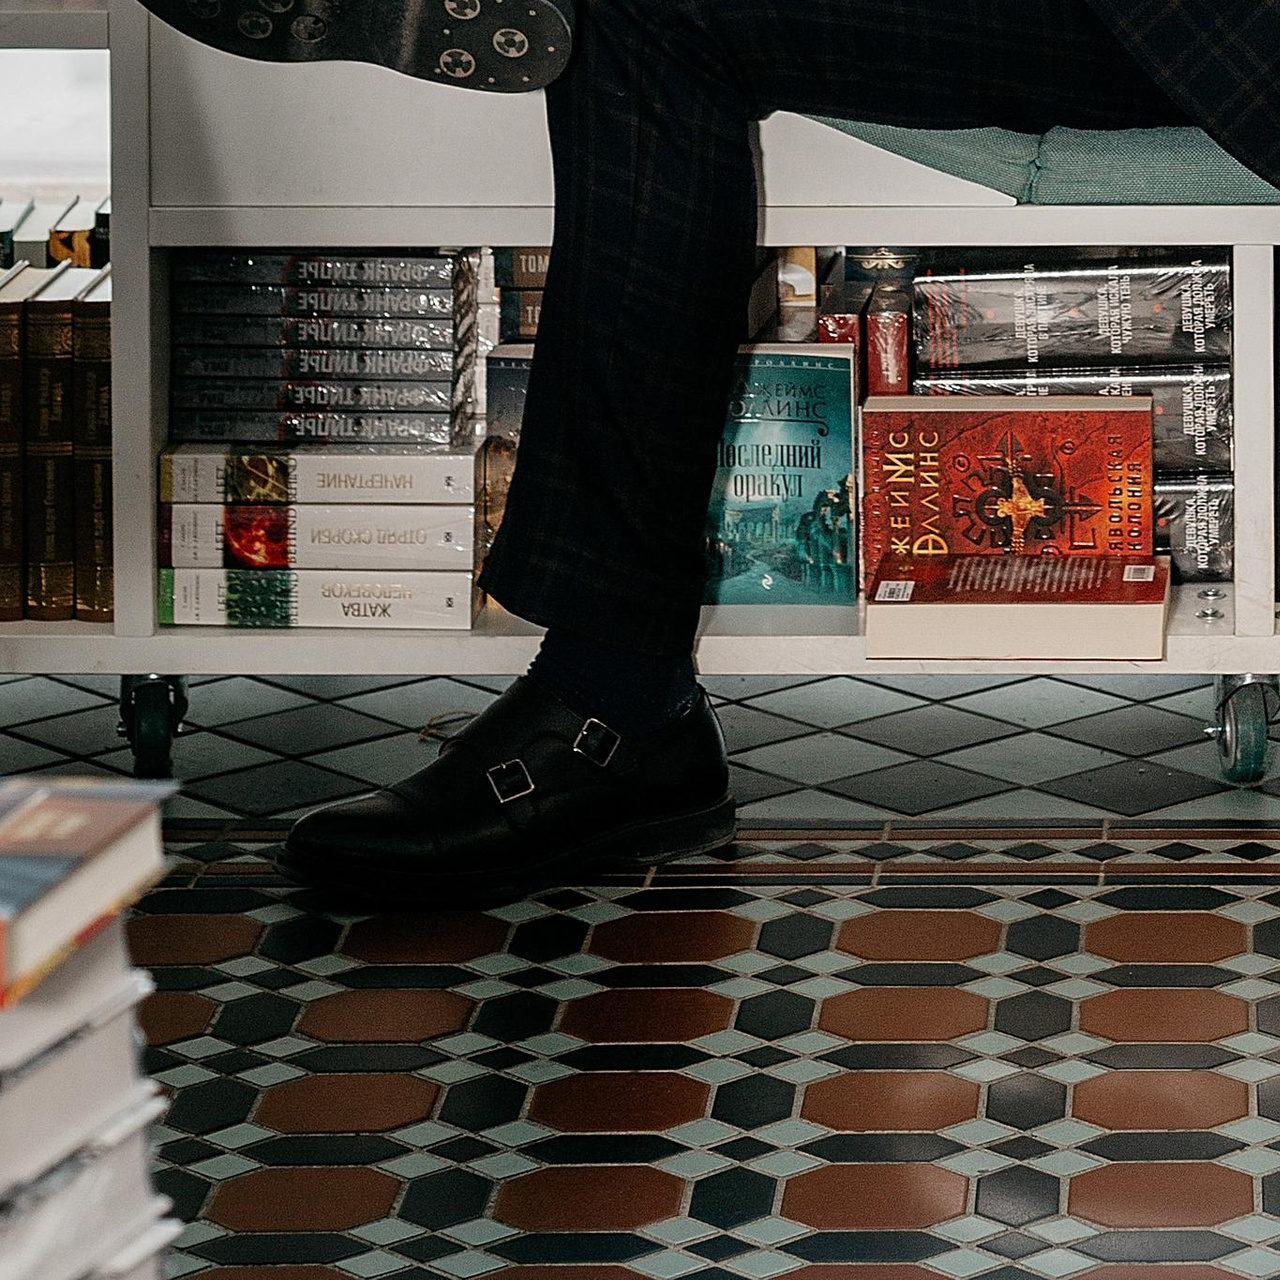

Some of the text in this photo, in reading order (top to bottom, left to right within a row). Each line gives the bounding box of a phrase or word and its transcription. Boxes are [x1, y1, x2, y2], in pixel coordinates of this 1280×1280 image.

[1119, 275, 1133, 344] ЧУЖУЮ ТЕНЬ
[1191, 260, 1206, 353] КОТОРАЯ ДОЛЖА
[1110, 310, 1122, 354] КОТОРАЯ
[299, 354, 358, 373] ТИЛЬЕ
[1195, 412, 1206, 455] КОТОРАЯ
[316, 472, 412, 489] НАЧЕРТАНИЕ
[733, 473, 804, 503] оракул
[882, 432, 916, 554] ЖЕЙМС
[1108, 435, 1124, 552] ЯВОЛЬСКАЯ
[1128, 462, 1143, 551] КОЛОНИЯ
[310, 528, 427, 546] ОТРЯД СКОРБИ
[1197, 525, 1208, 569] КОТОРАЯ
[341, 602, 391, 618] ЖАТВА
